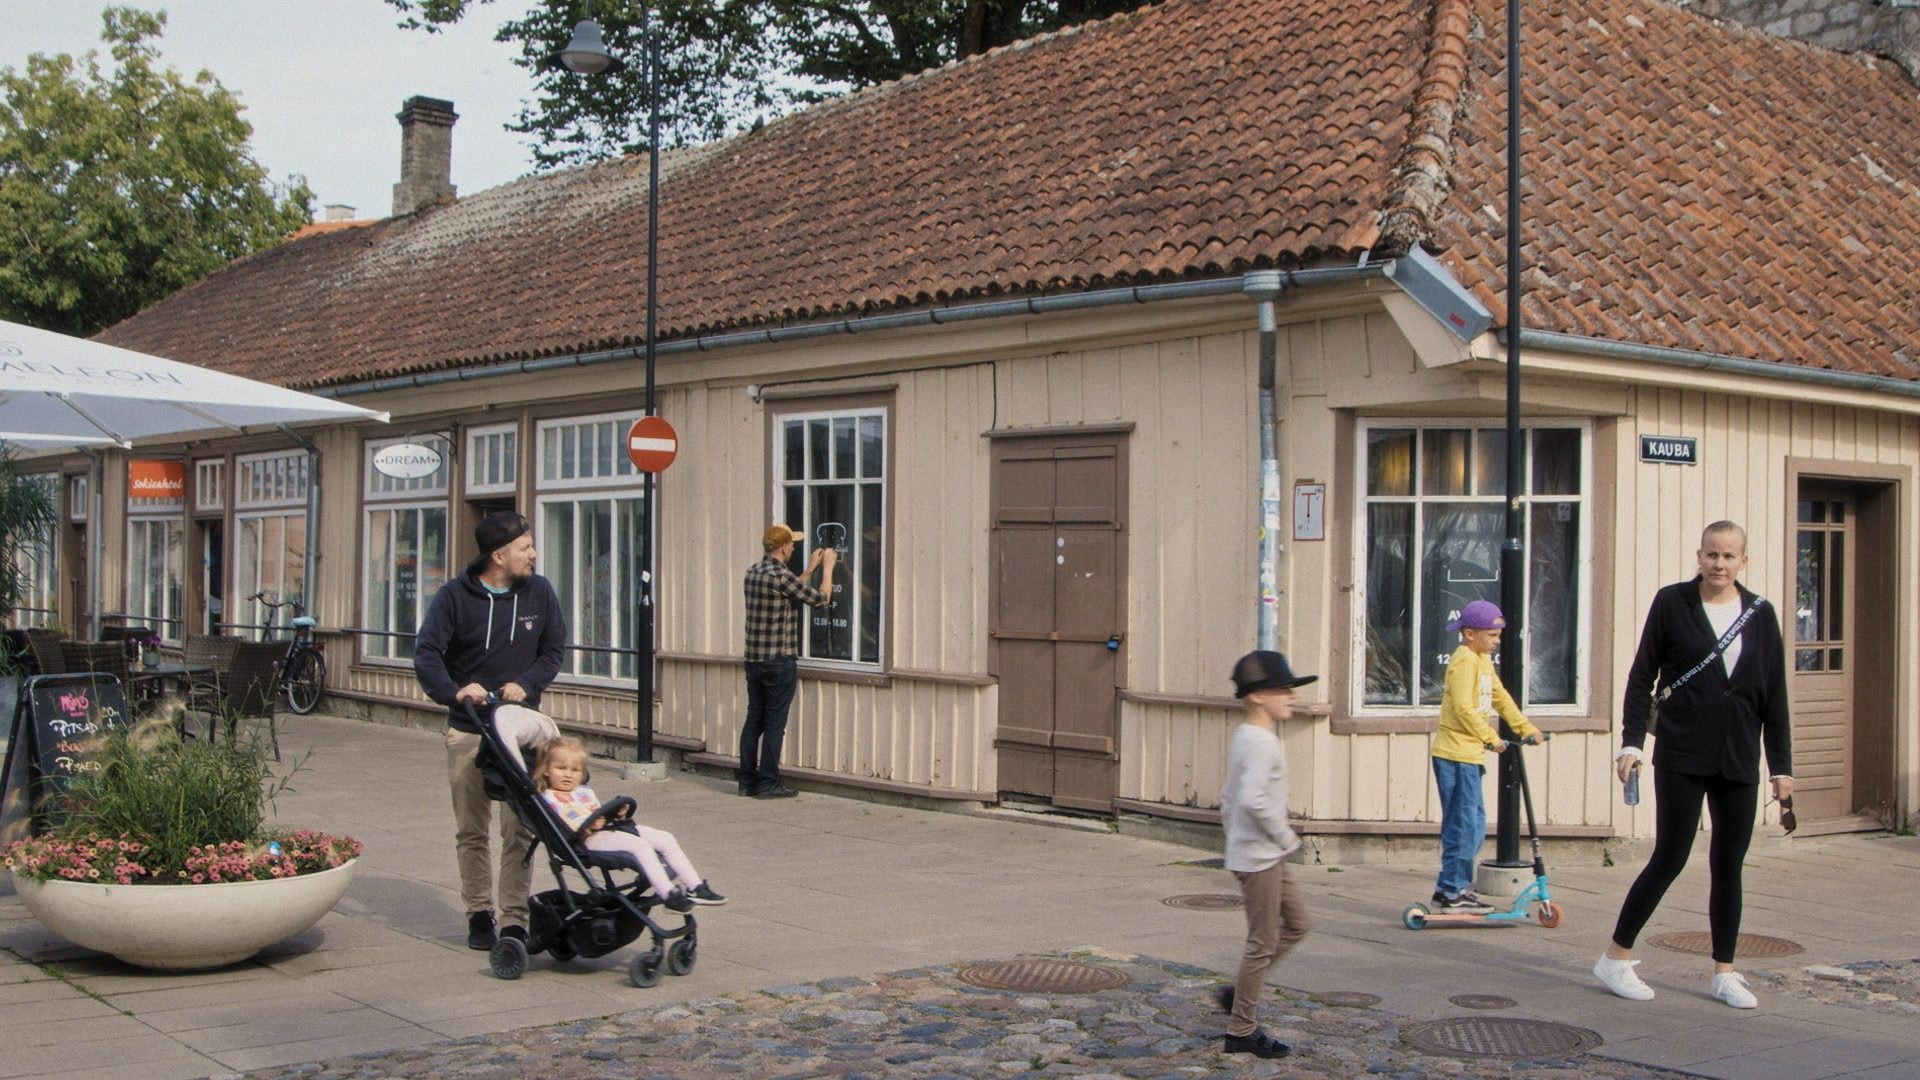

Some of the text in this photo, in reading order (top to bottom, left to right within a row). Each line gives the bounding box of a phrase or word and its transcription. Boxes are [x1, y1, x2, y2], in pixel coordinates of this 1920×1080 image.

[385, 455, 431, 465] DREAM
[1649, 441, 1690, 458] KAUBA
[1718, 607, 1755, 649] marimekko
[1671, 651, 1718, 690] marimekko
